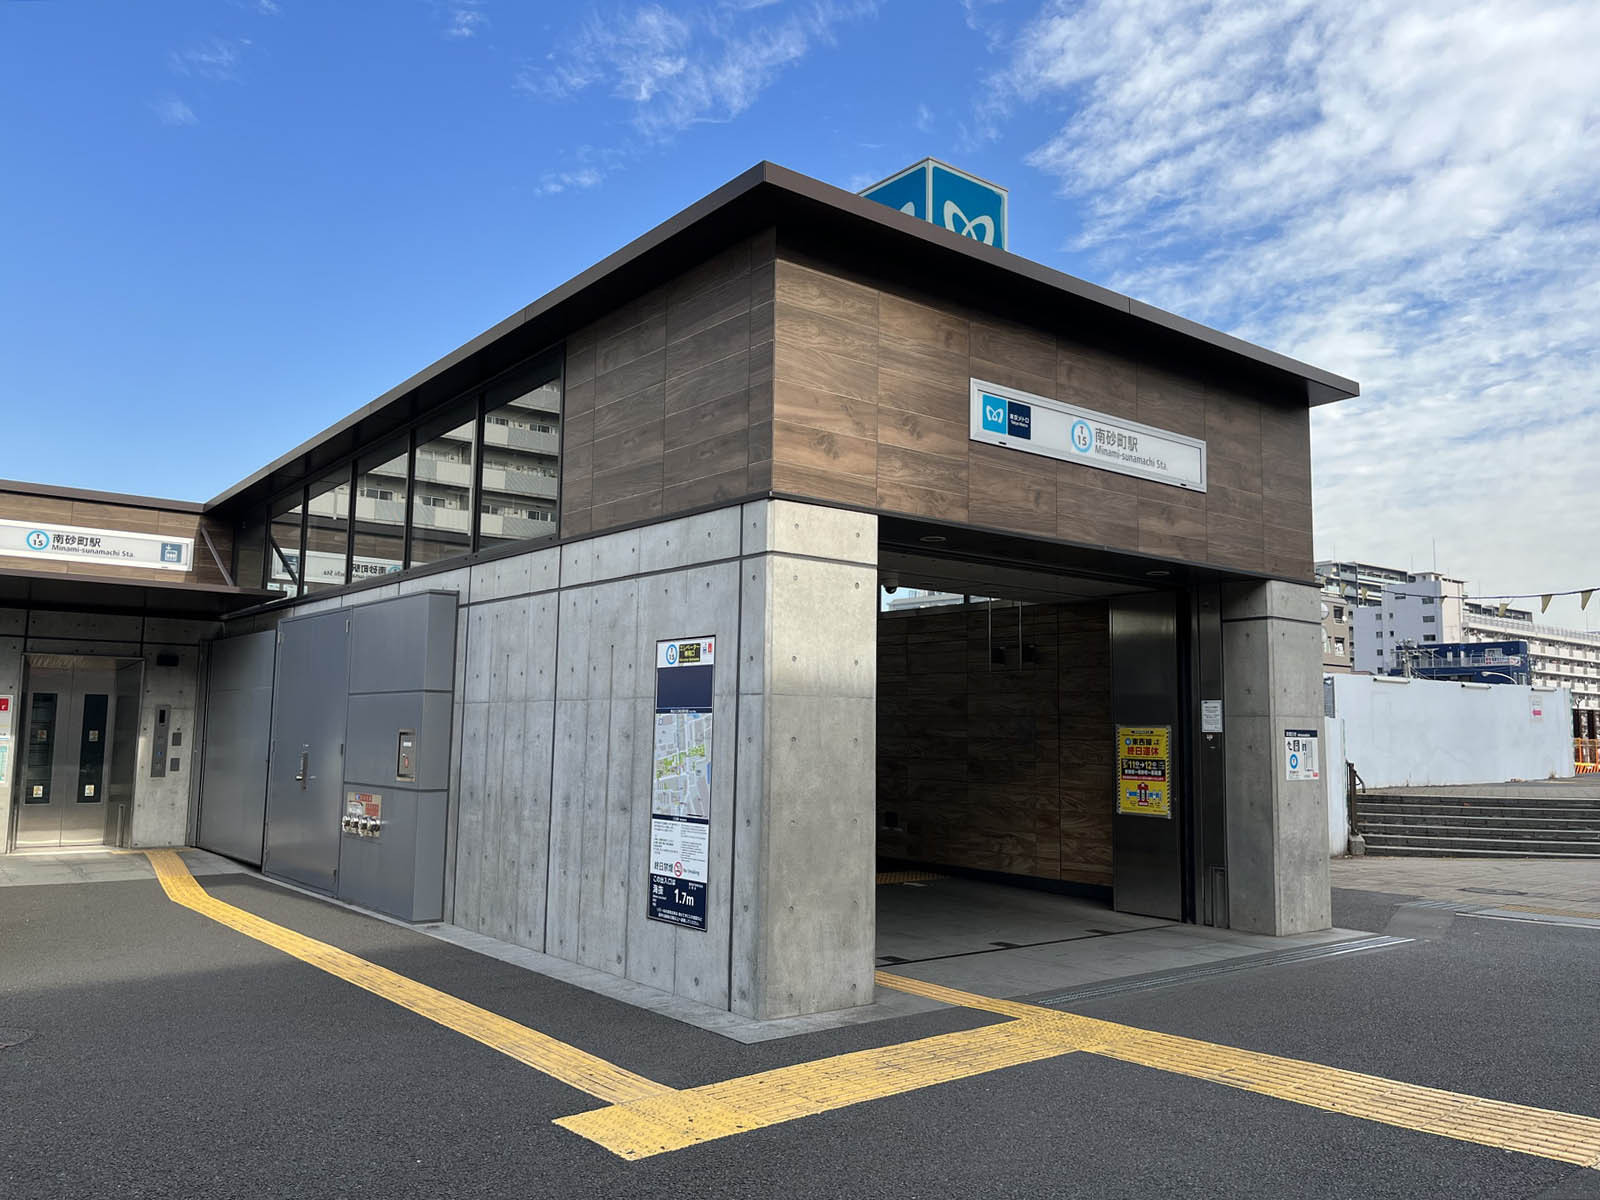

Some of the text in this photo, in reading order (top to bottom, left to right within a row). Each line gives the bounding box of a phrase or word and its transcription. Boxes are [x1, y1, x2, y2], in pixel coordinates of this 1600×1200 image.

[1076, 436, 1088, 447] 15
[1095, 427, 1138, 453] 南砂町駅
[1094, 444, 1168, 471] Minami-sunamachi Sta.
[52, 534, 101, 547] 南砂町駅
[51, 544, 120, 557] Minami-sunamachi
[674, 888, 694, 906] 1.7m
